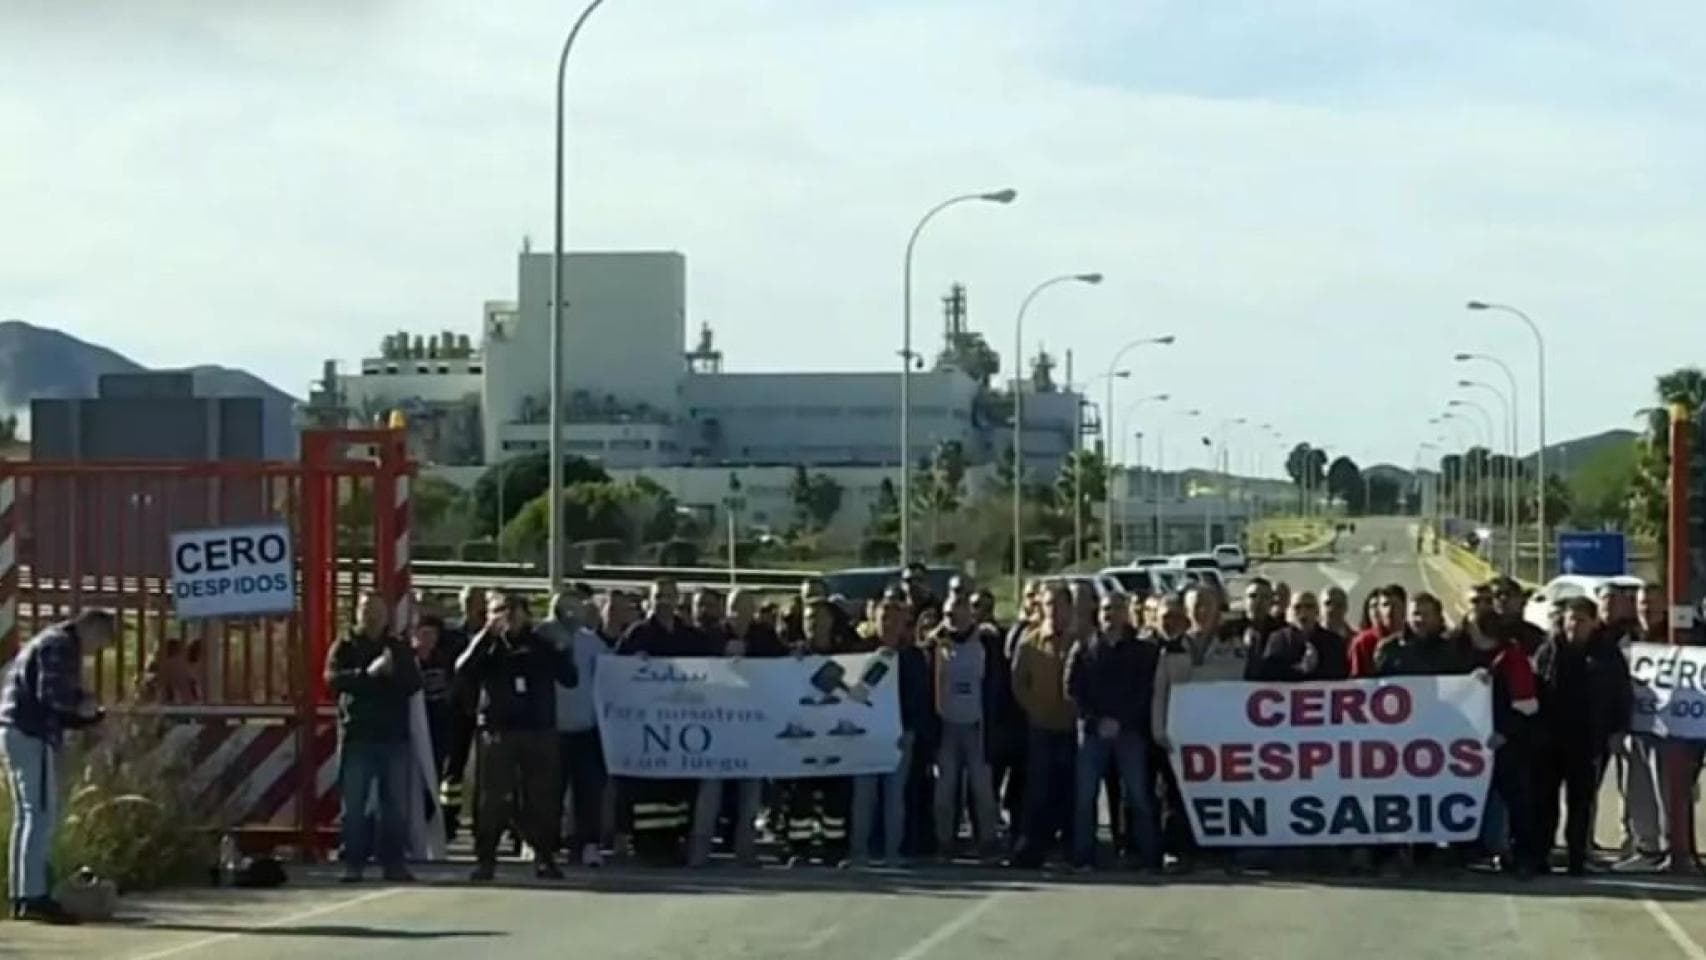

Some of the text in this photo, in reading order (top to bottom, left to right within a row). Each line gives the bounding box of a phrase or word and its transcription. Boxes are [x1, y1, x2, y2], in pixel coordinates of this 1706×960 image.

[176, 534, 286, 573] CERO
[176, 573, 288, 598] DESPIDOS
[1634, 656, 1706, 691] CER
[1246, 685, 1413, 728] CERO
[643, 723, 713, 753] NO
[1180, 738, 1486, 782] DESPIDOS
[1191, 793, 1477, 837] EN SABIC
